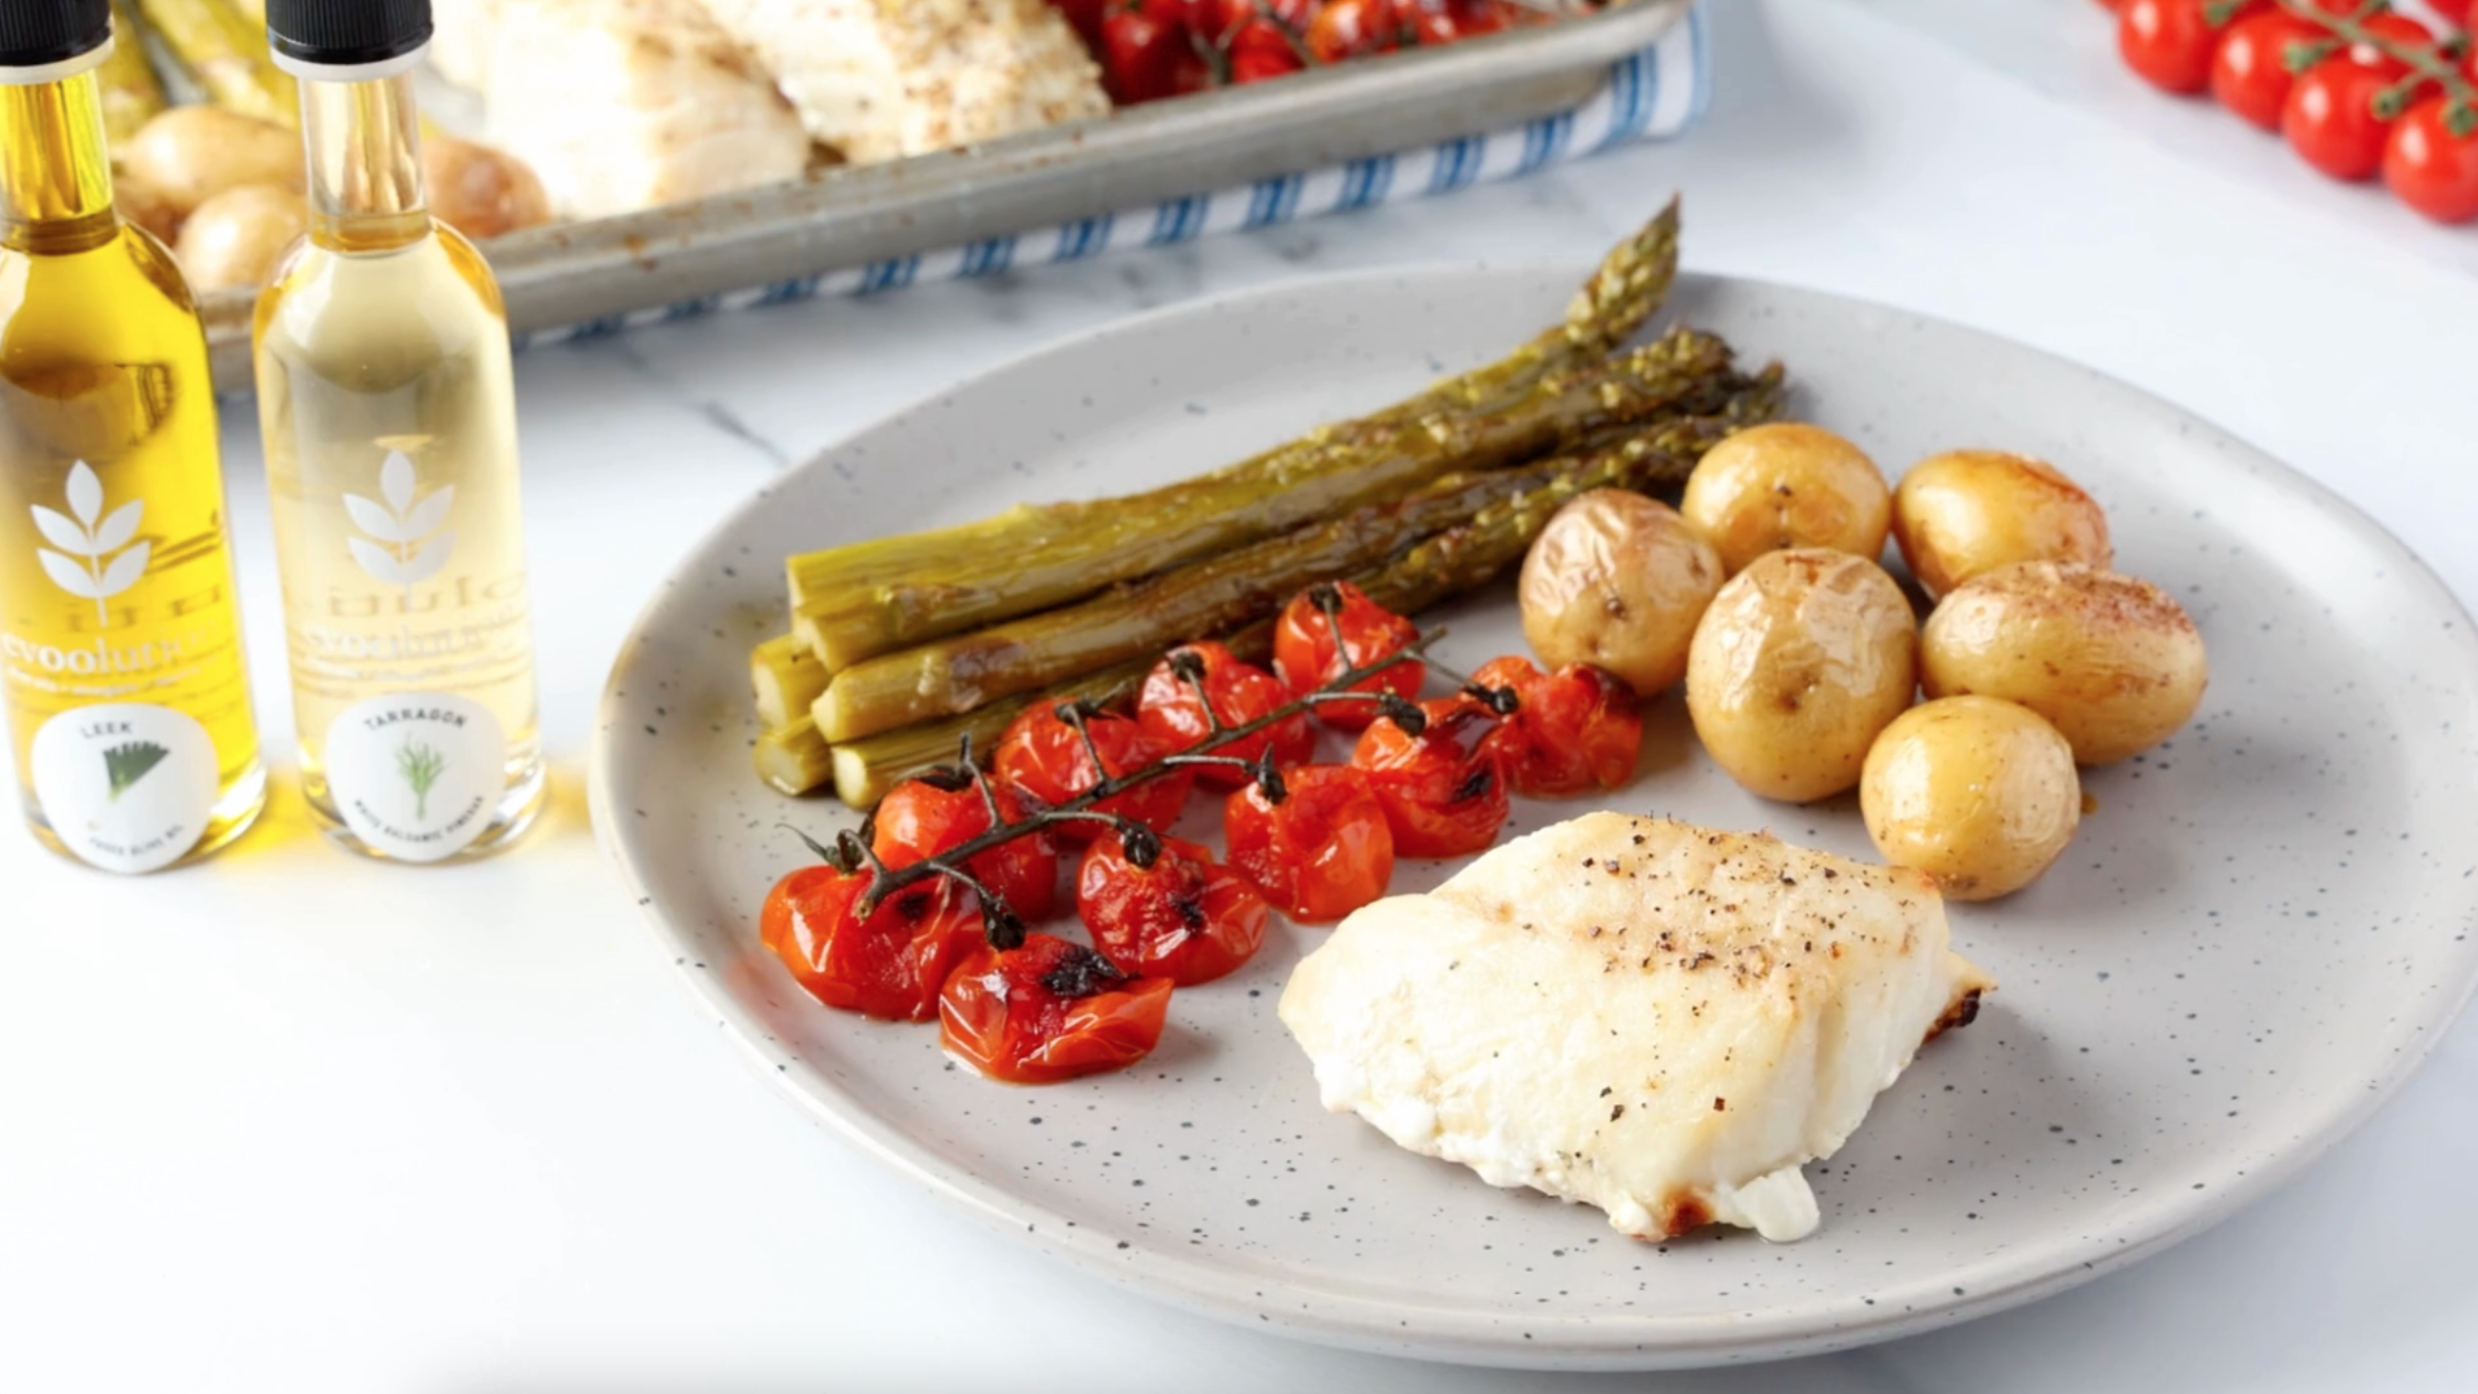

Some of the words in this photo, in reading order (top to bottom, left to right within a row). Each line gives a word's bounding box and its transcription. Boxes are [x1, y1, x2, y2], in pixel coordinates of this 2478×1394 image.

[364, 708, 467, 731] TARRAGON
[80, 721, 134, 739] LEEK
[384, 824, 444, 843] BALSAMIC
